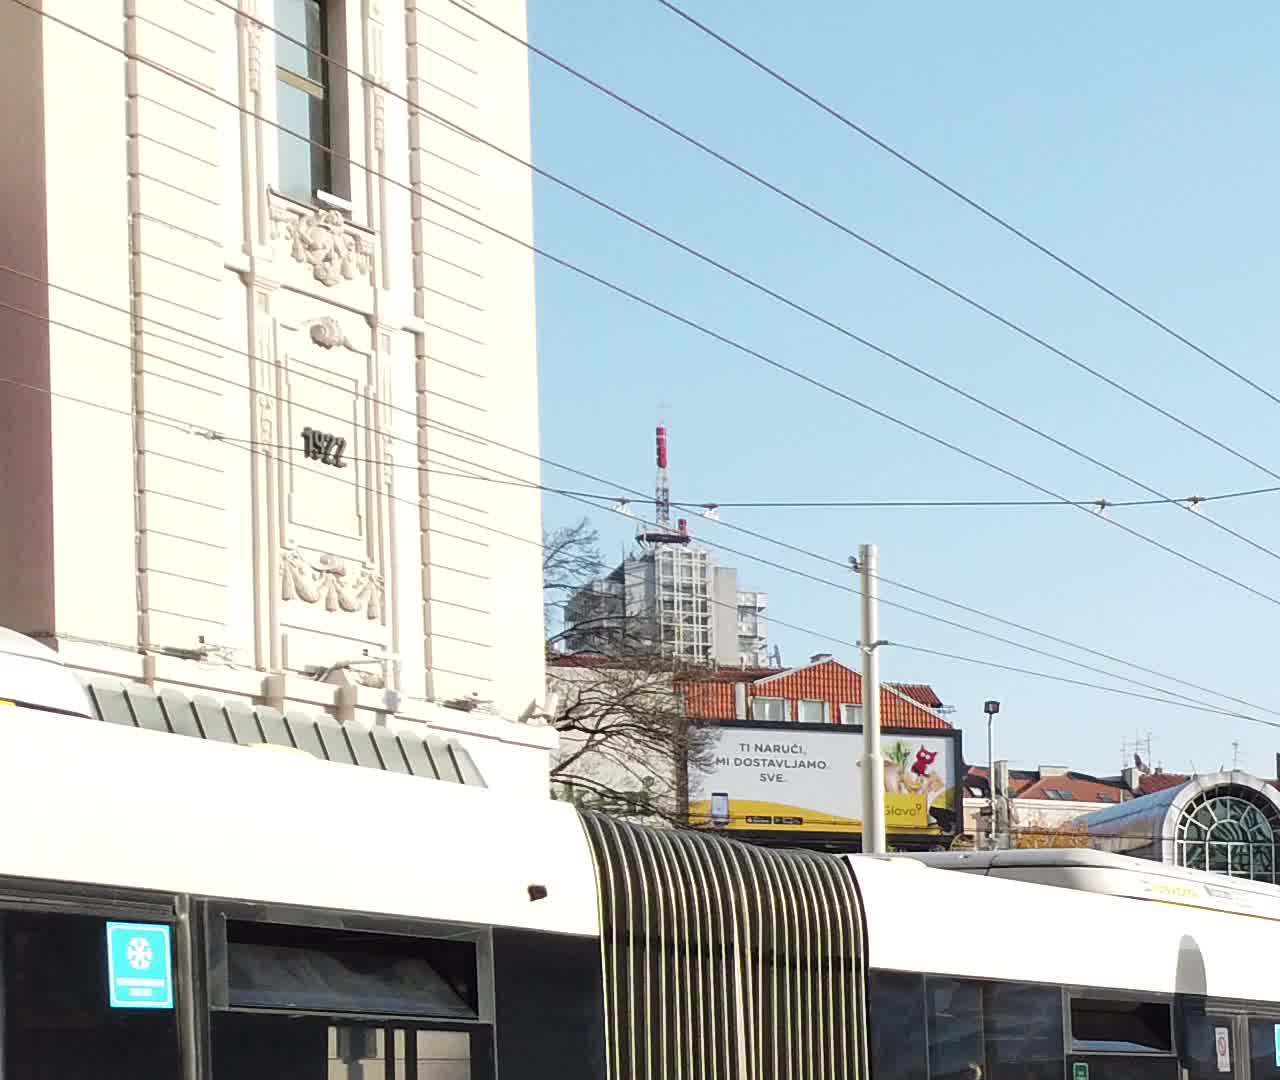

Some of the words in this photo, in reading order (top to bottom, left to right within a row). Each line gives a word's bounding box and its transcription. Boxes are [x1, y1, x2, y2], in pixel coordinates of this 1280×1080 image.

[301, 427, 347, 468] 1922
[740, 743, 750, 753] TI
[716, 756, 729, 766] MI
[734, 757, 827, 770] DOSTAVLJAMO
